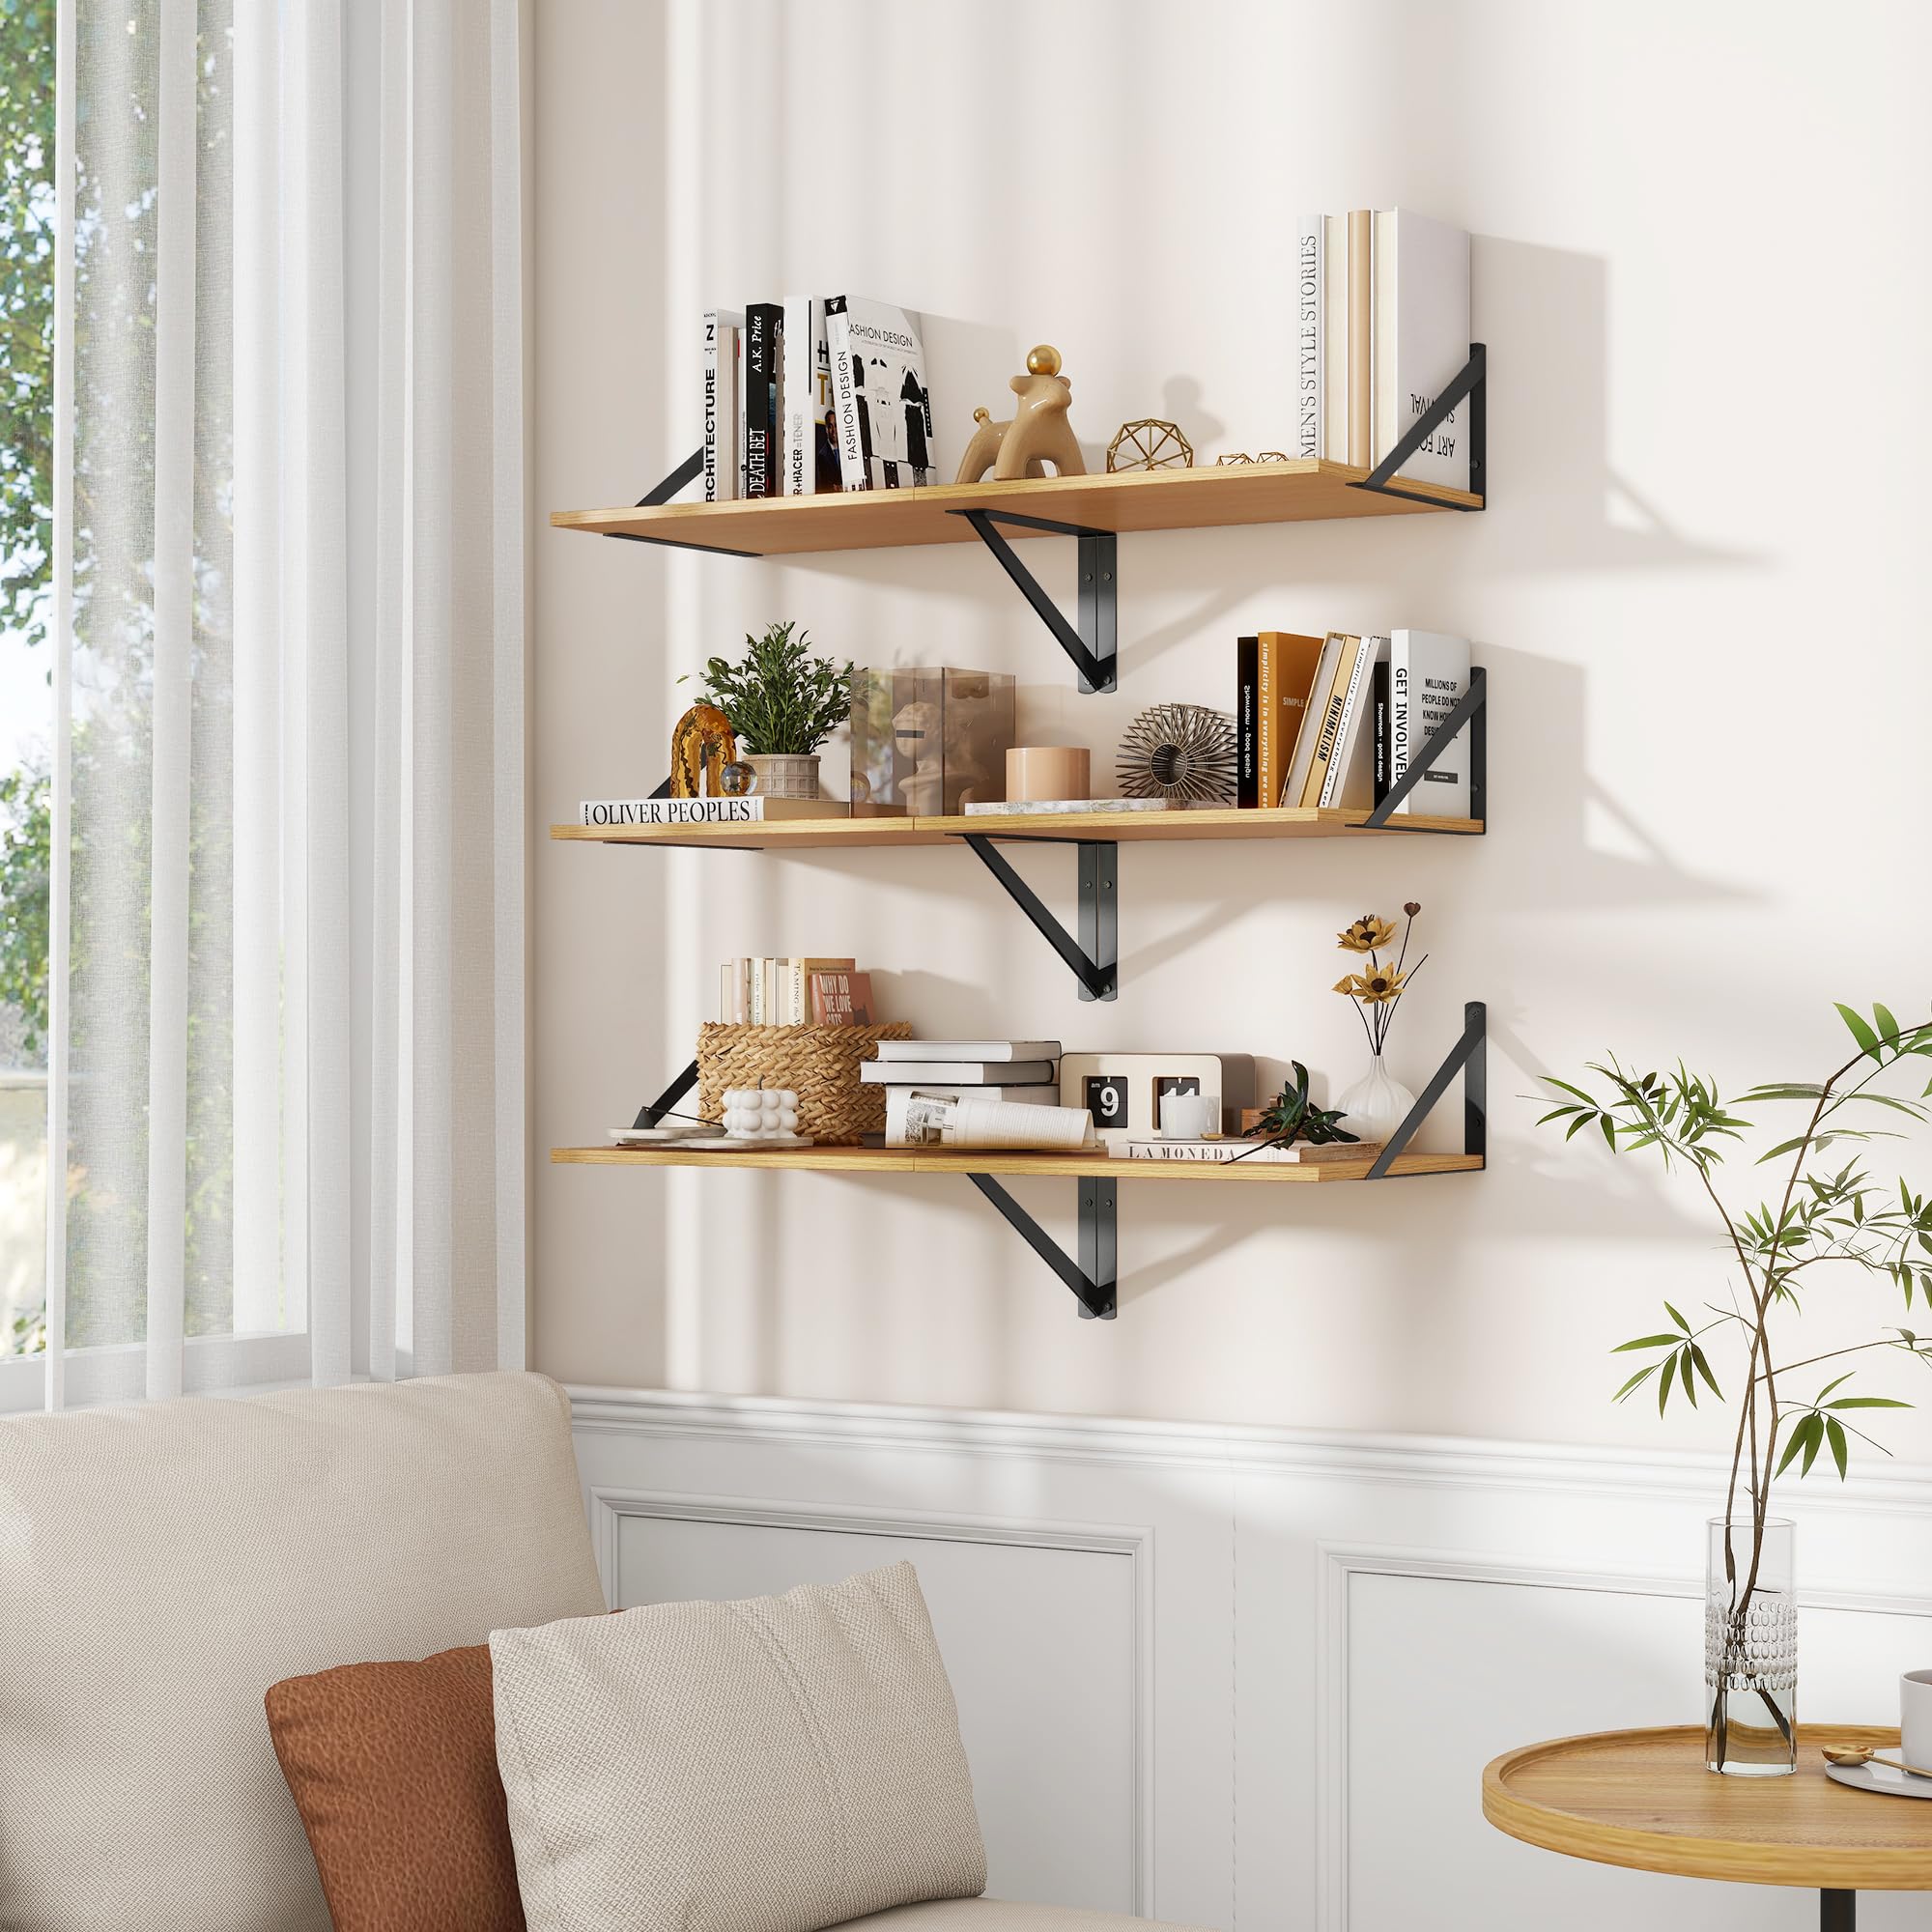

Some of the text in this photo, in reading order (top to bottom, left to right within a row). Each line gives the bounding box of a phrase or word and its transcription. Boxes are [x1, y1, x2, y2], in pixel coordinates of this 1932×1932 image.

[752, 315, 762, 372] A.K. Price
[849, 324, 881, 340] ASHION
[883, 330, 913, 347] DESIGN
[1300, 235, 1317, 458] MEN'S STYLE STORIES
[838, 351, 858, 461] FASHION DESIGN
[705, 368, 715, 502] RCHITECTURE
[749, 427, 766, 449] BET
[1417, 433, 1456, 458] ART FO
[749, 452, 765, 493] DEATH
[1262, 642, 1270, 692] simplicity
[1350, 648, 1365, 694] simplicity
[1425, 678, 1458, 692] MILLIONS OF
[1263, 695, 1270, 704] is
[1263, 706, 1270, 717] in
[1282, 696, 1304, 708] SIMPLE
[1422, 694, 1441, 705] PEOPLE
[1442, 696, 1450, 707] DO
[1317, 695, 1343, 762] MINIMALISM
[1396, 668, 1407, 781] GET INVOLVED
[1422, 709, 1450, 723] KNOW HO
[1329, 722, 1346, 772] everything
[1263, 775, 1268, 789] we
[592, 803, 664, 825] OLIVER
[668, 800, 751, 823] PEOPLES
[819, 975, 849, 994] WHY DO
[823, 995, 853, 1012] WE LOVE
[1099, 1086, 1120, 1117] 9
[1128, 1146, 1236, 1160] LA MONEDA
